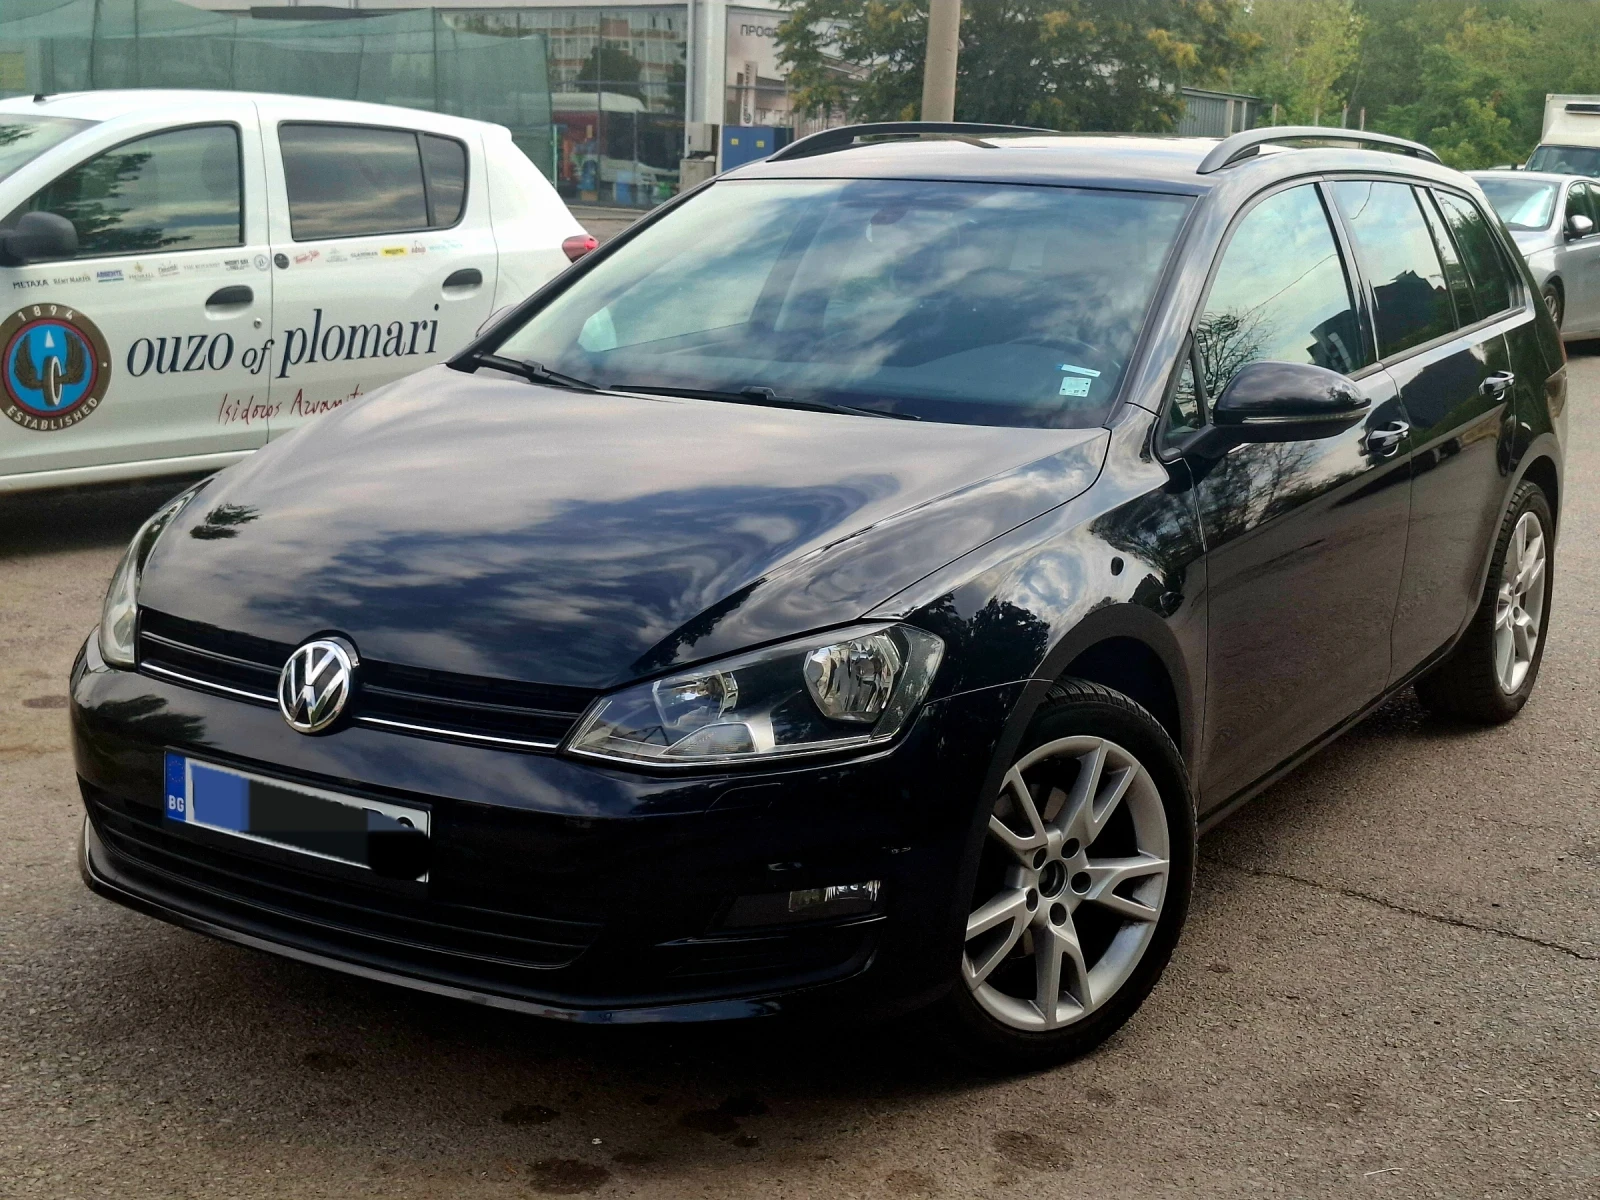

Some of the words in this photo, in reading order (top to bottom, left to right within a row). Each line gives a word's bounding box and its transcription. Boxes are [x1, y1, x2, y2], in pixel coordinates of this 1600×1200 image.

[13, 279, 49, 289] METAXA
[18, 304, 75, 323] 1894
[126, 332, 235, 378] ouzo
[241, 338, 275, 375] of
[275, 303, 440, 379] plomari
[6, 397, 99, 432] ESTABLISHED
[168, 794, 185, 813] BG
